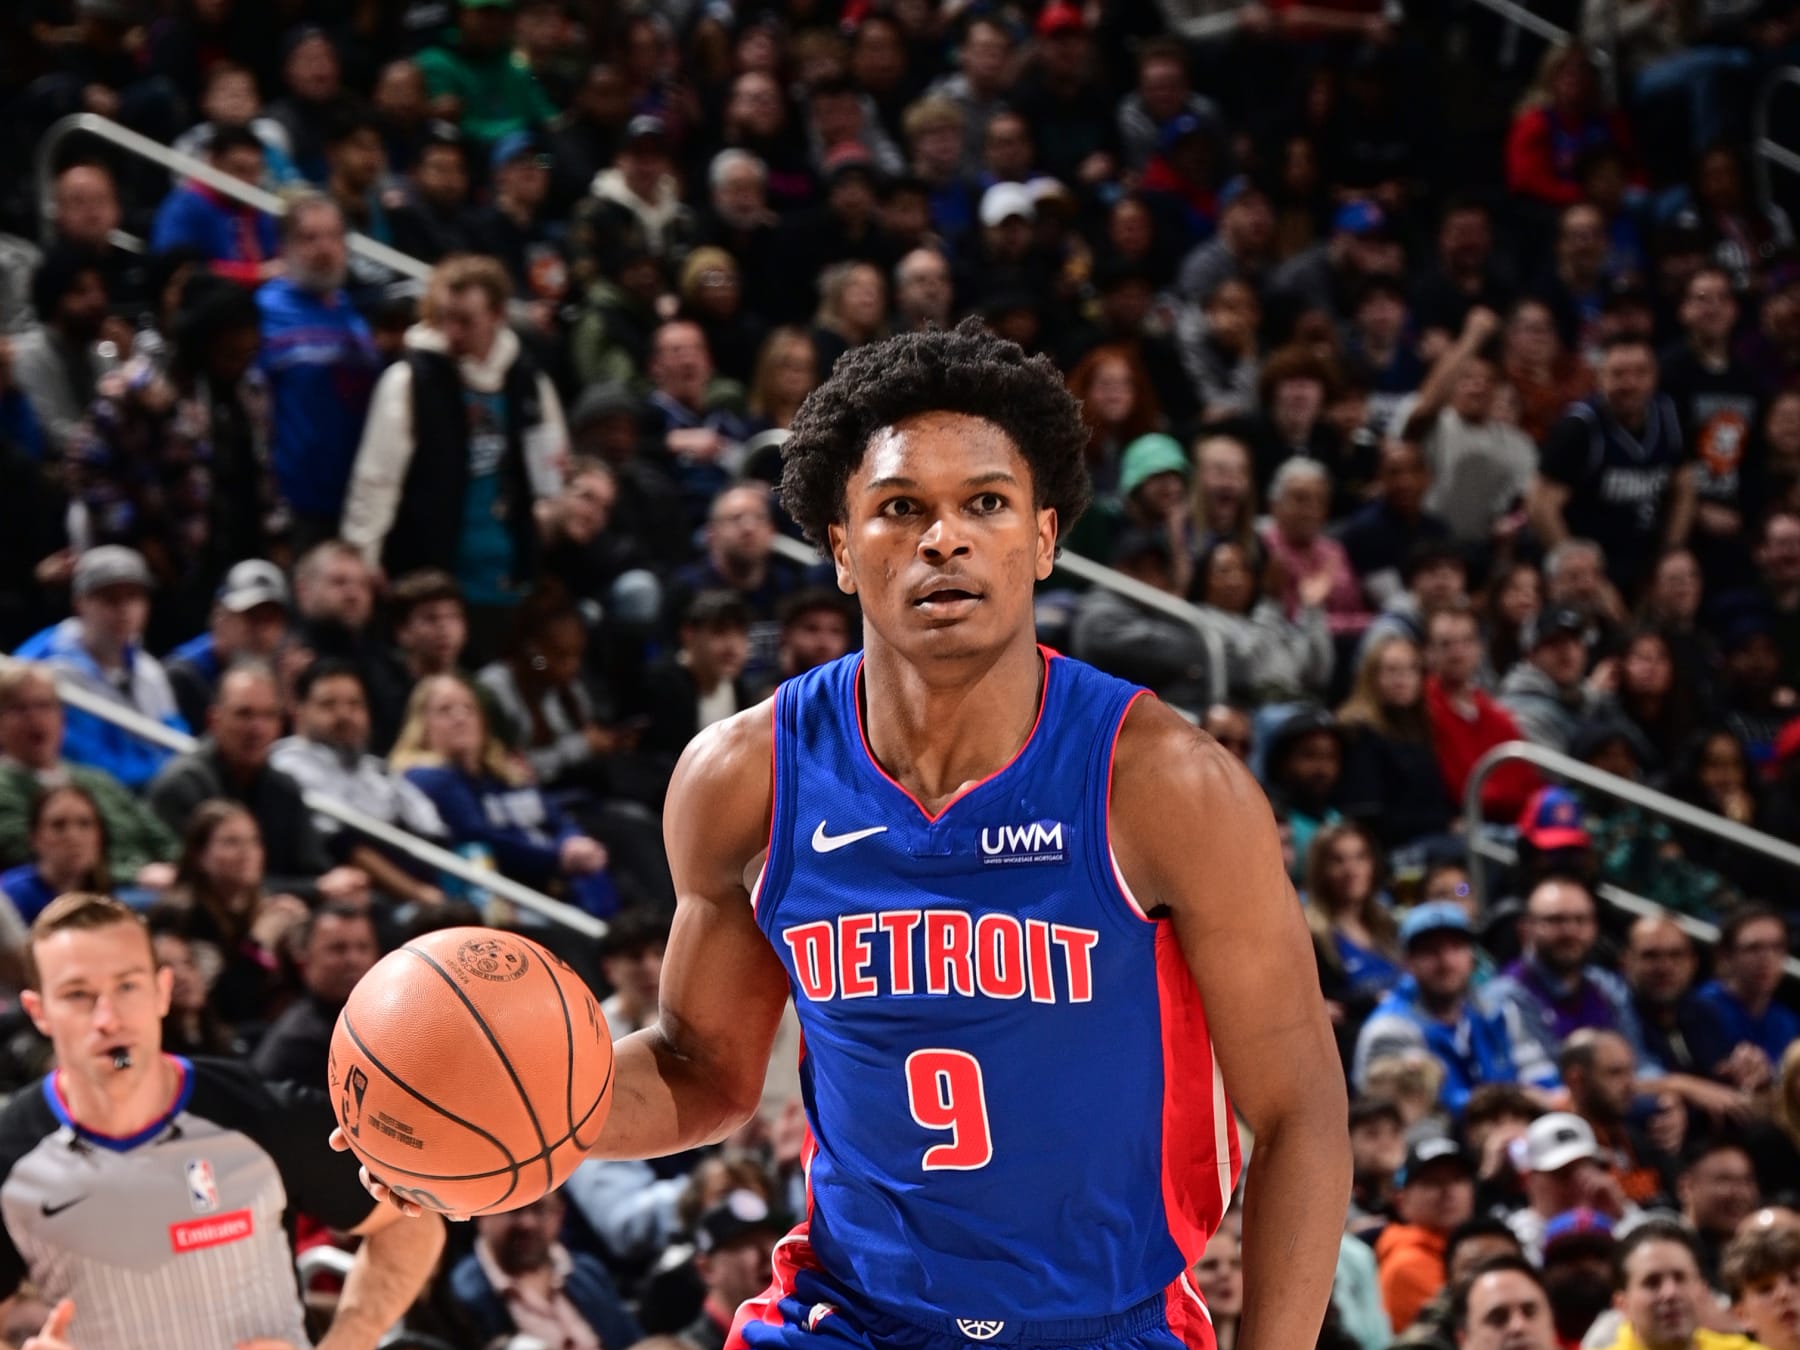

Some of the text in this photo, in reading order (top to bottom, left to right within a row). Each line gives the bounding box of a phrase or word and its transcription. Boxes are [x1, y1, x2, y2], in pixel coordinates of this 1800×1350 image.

[981, 821, 1063, 855] UWM
[783, 910, 1099, 1004] DETROIT
[905, 1048, 993, 1171] 9
